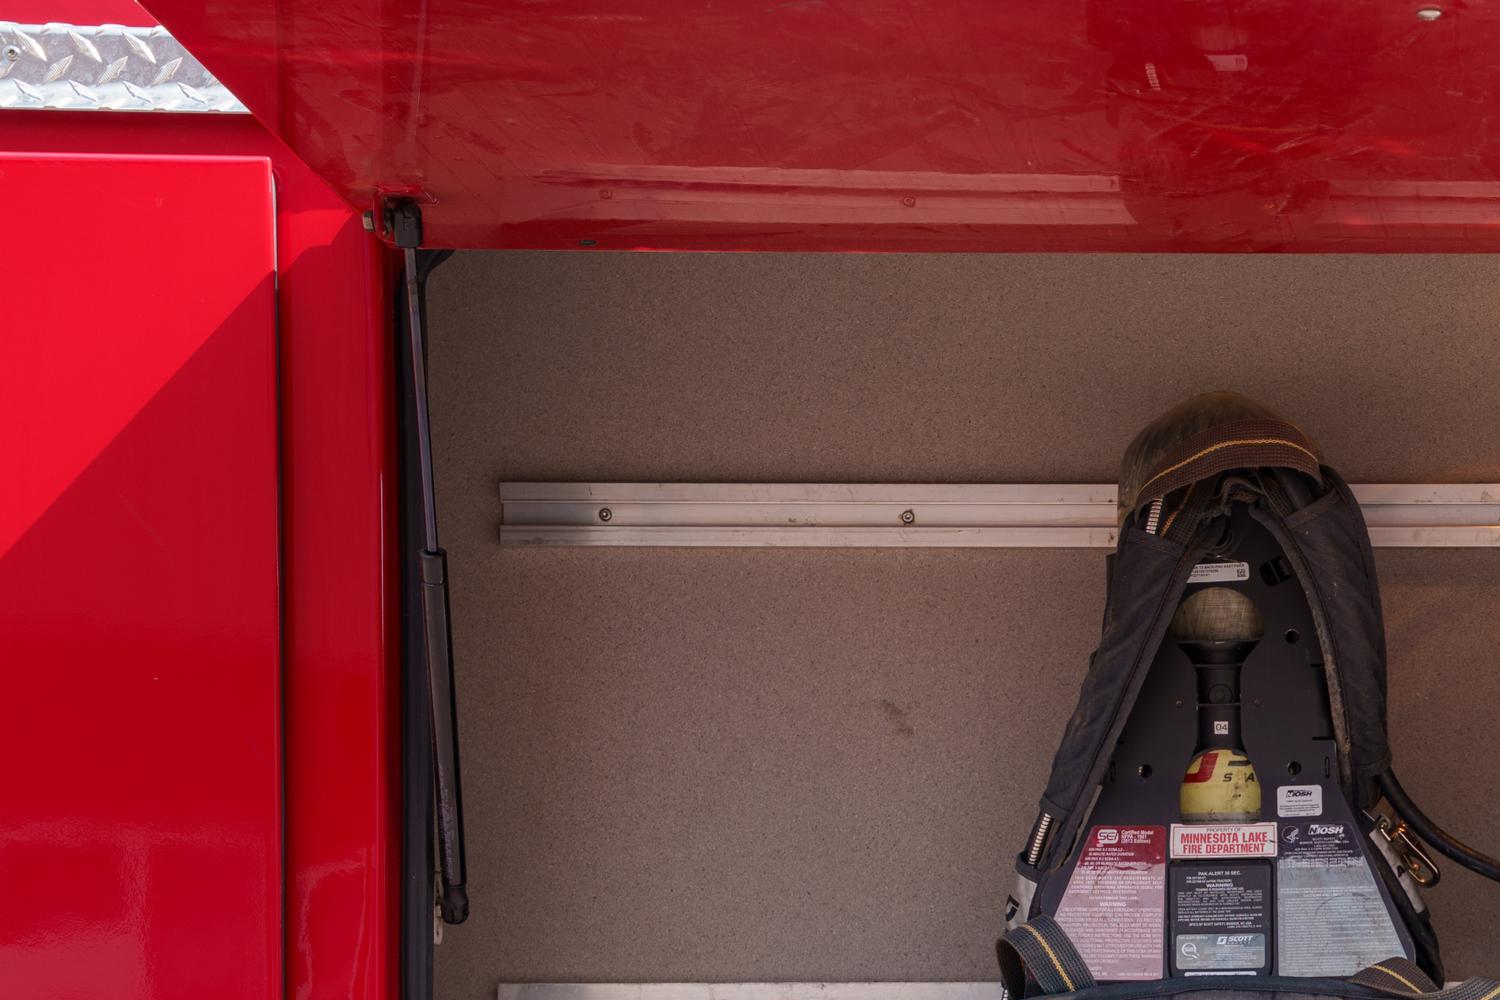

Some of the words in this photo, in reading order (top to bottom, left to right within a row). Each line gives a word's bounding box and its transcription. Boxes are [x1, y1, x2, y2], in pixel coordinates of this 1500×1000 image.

[1308, 824, 1344, 835] NIOSH
[1180, 832, 1239, 843] MINNESOTA
[1242, 832, 1267, 842] LAKE
[1183, 844, 1202, 853] FIRE
[1206, 843, 1265, 853] DEPARTMENT
